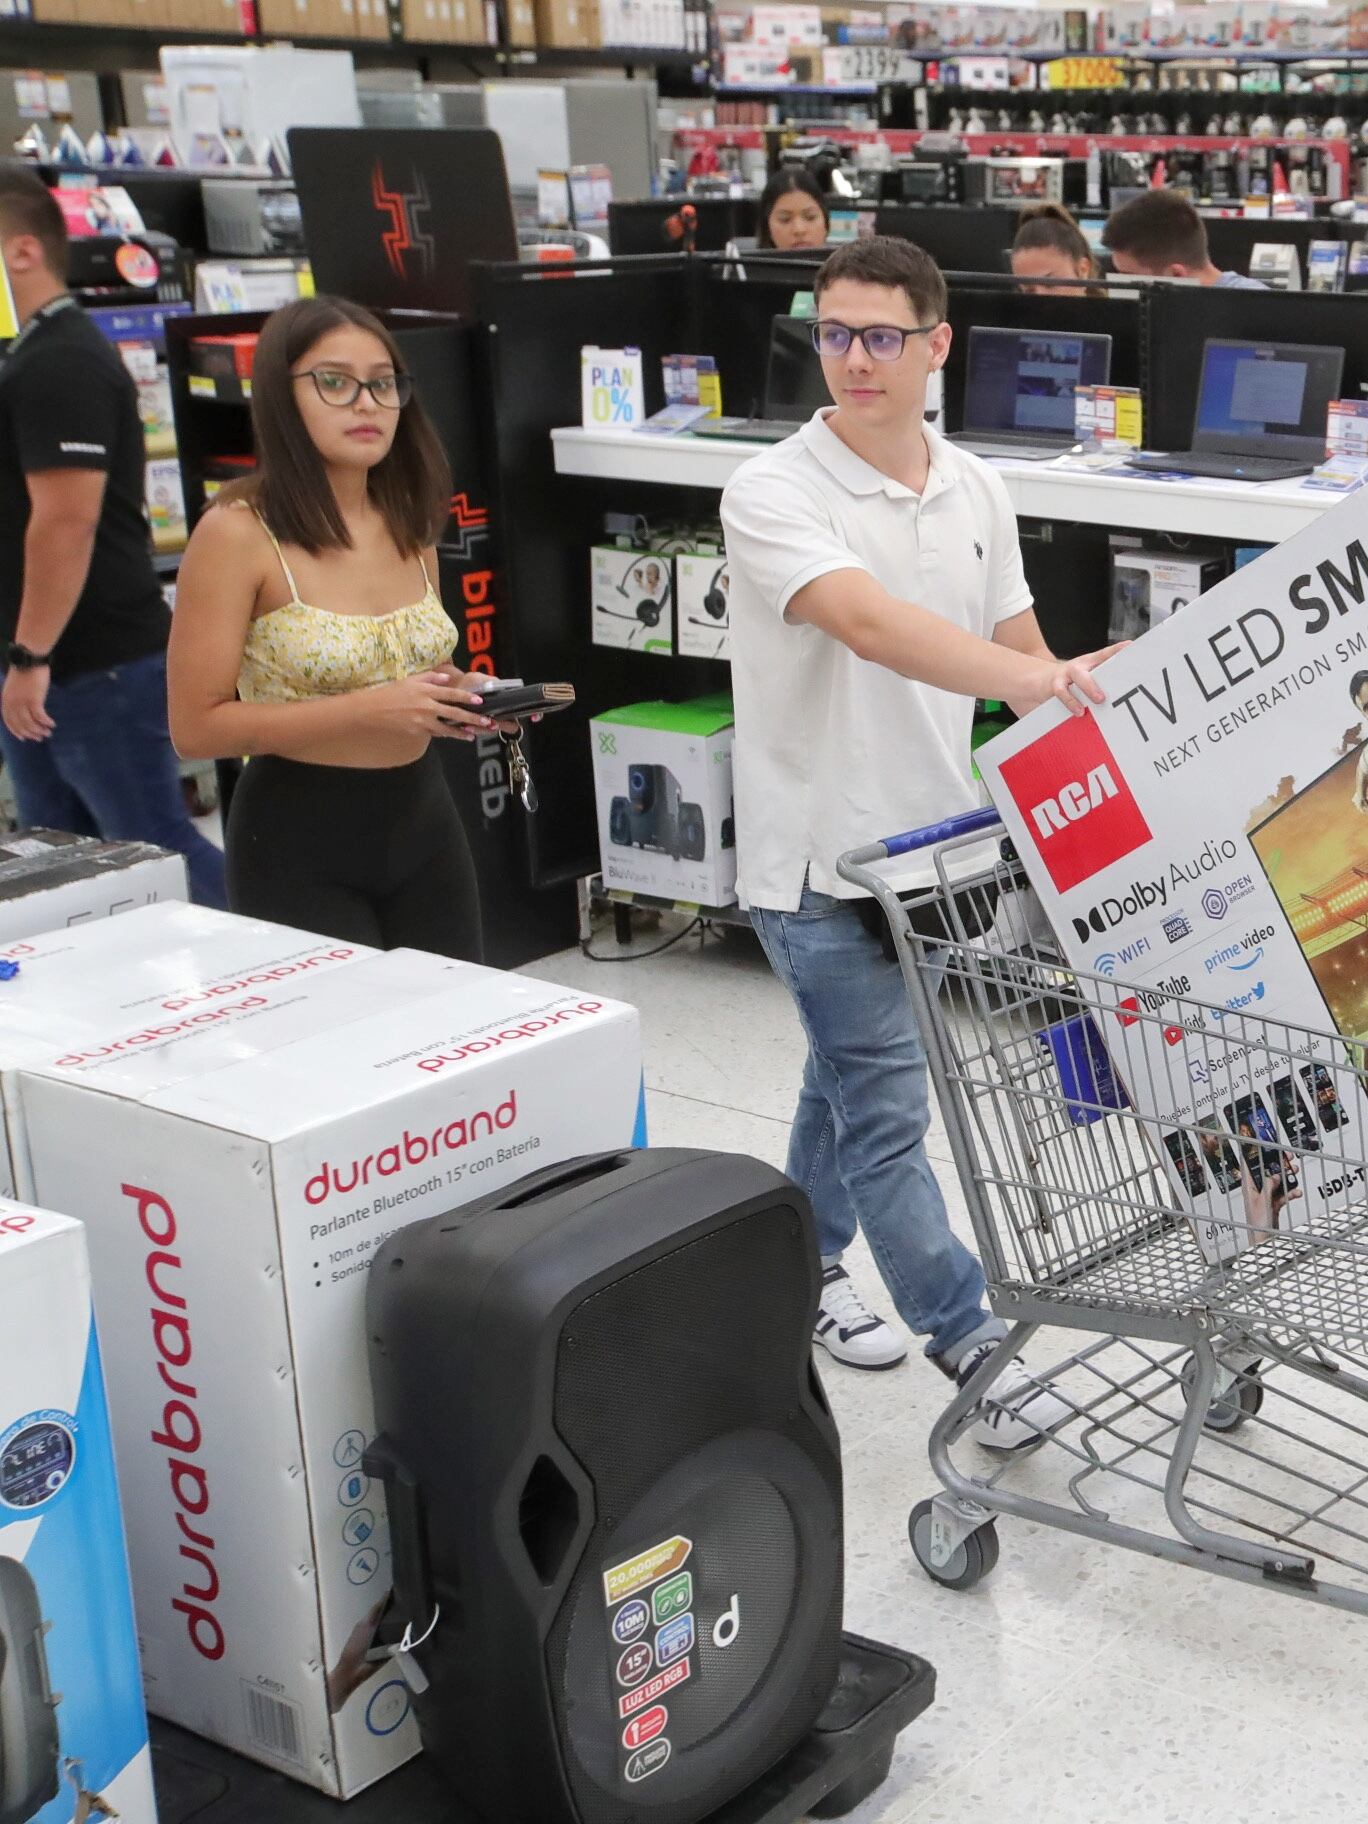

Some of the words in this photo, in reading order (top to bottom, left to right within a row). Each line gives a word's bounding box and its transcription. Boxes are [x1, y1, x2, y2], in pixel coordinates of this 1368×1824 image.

[591, 367, 633, 386] PLAN
[592, 387, 633, 423] 0%
[1112, 667, 1178, 743] TV
[1183, 607, 1286, 703] LED
[1153, 738, 1202, 778] NEXT
[1206, 653, 1334, 744] GENERATION
[1030, 762, 1121, 840] RCA
[1101, 876, 1168, 927] Dolby
[1169, 839, 1237, 892] Audio
[1224, 874, 1253, 897] OPEN
[1228, 885, 1256, 904] BROWSER
[1164, 920, 1183, 934] QUAD
[1168, 928, 1188, 942] CORE
[1117, 937, 1152, 965] WIFI
[1204, 942, 1241, 975] prime
[1240, 925, 1275, 950] video
[1137, 975, 1192, 1014] YouTube
[55, 996, 269, 1067] durabrand
[416, 1001, 604, 1073] durabrand
[1254, 1059, 1281, 1079] desde
[303, 1089, 517, 1205] durabrand
[309, 1205, 371, 1240] Parlante
[373, 1175, 443, 1215] Bluetooth
[446, 1163, 468, 1183] 15"
[468, 1157, 495, 1176] con
[496, 1135, 541, 1164] Batería
[328, 1246, 354, 1264] 10m
[356, 1239, 372, 1252] de
[330, 1258, 373, 1284] Sonido
[121, 1182, 227, 1662] durabrand
[617, 1609, 645, 1633] 10M
[624, 1691, 645, 1710] LUZ
[644, 1681, 663, 1698] LED
[663, 1666, 684, 1687] RGB
